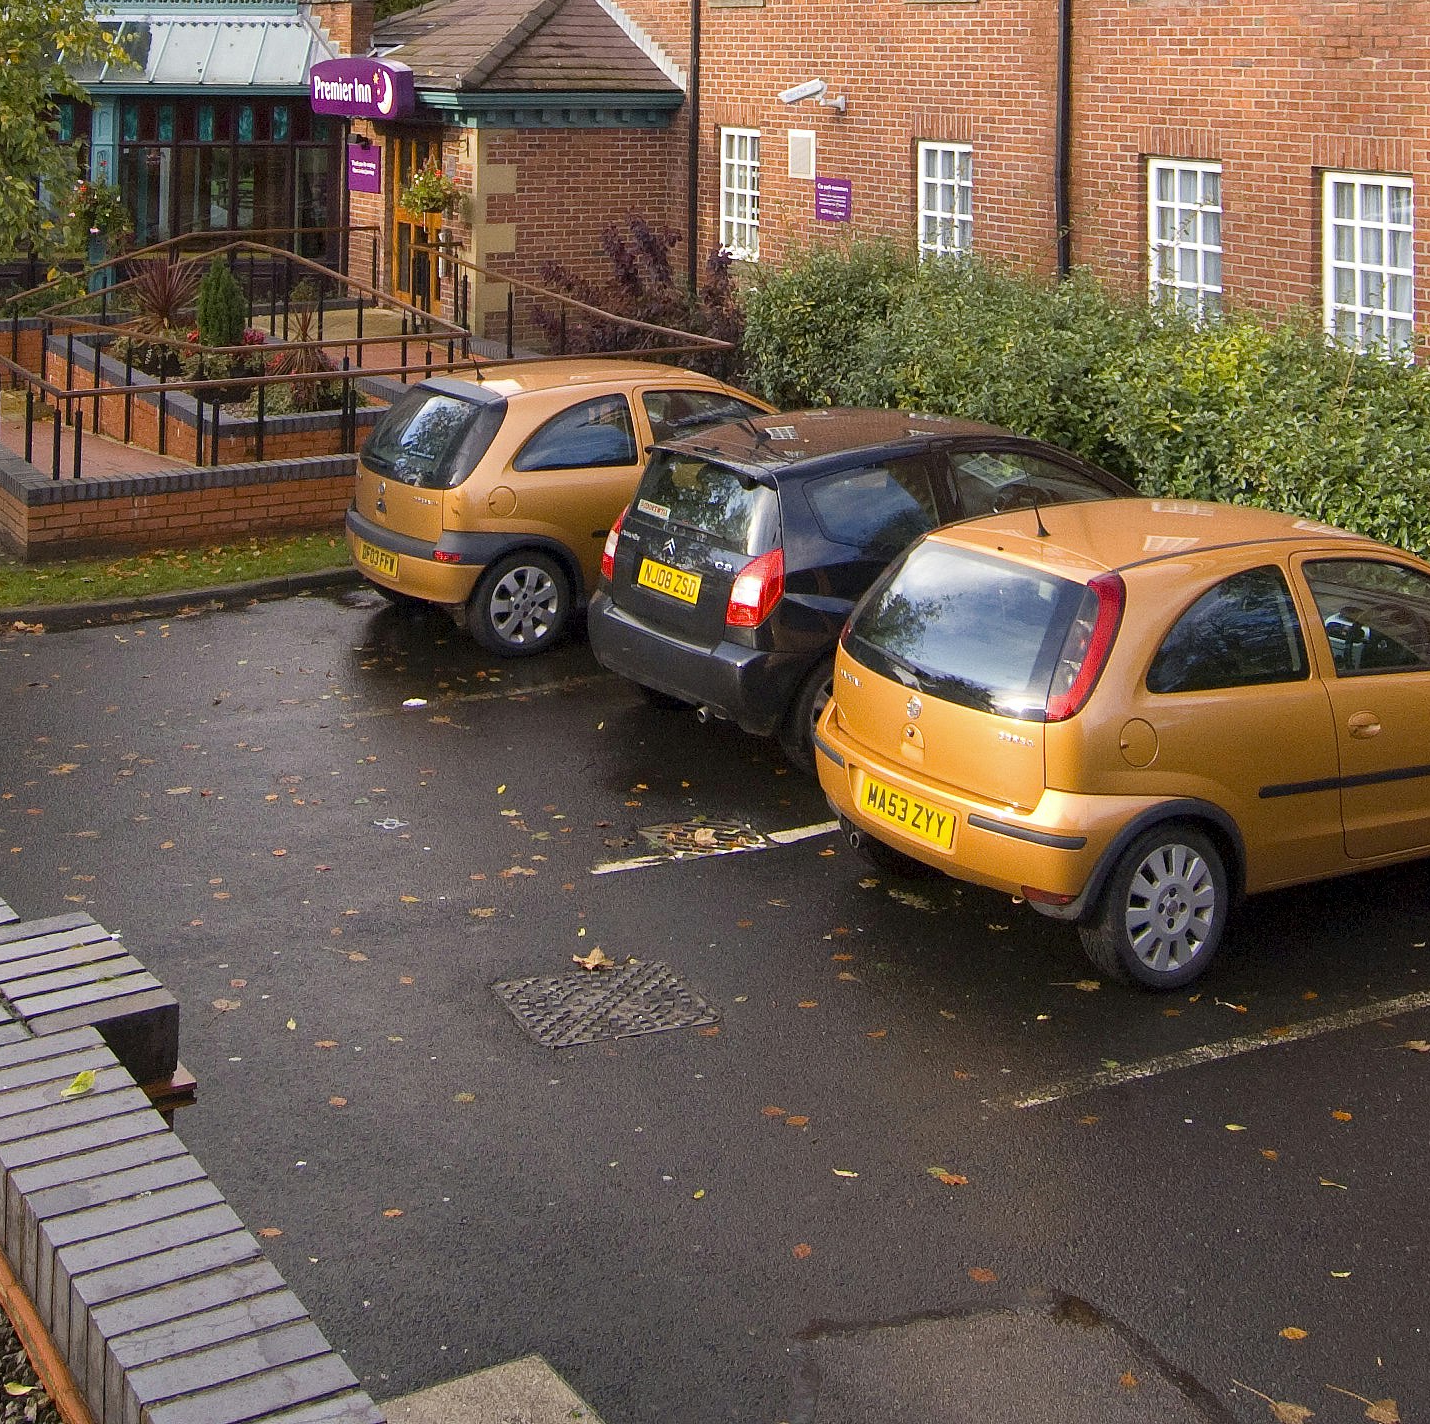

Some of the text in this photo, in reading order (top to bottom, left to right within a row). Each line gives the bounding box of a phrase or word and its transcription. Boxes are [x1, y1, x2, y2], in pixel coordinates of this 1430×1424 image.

[313, 75, 372, 104] Premier Inn
[643, 563, 697, 598] NJ08 ZSD
[867, 782, 947, 838] MA53 ZYY
